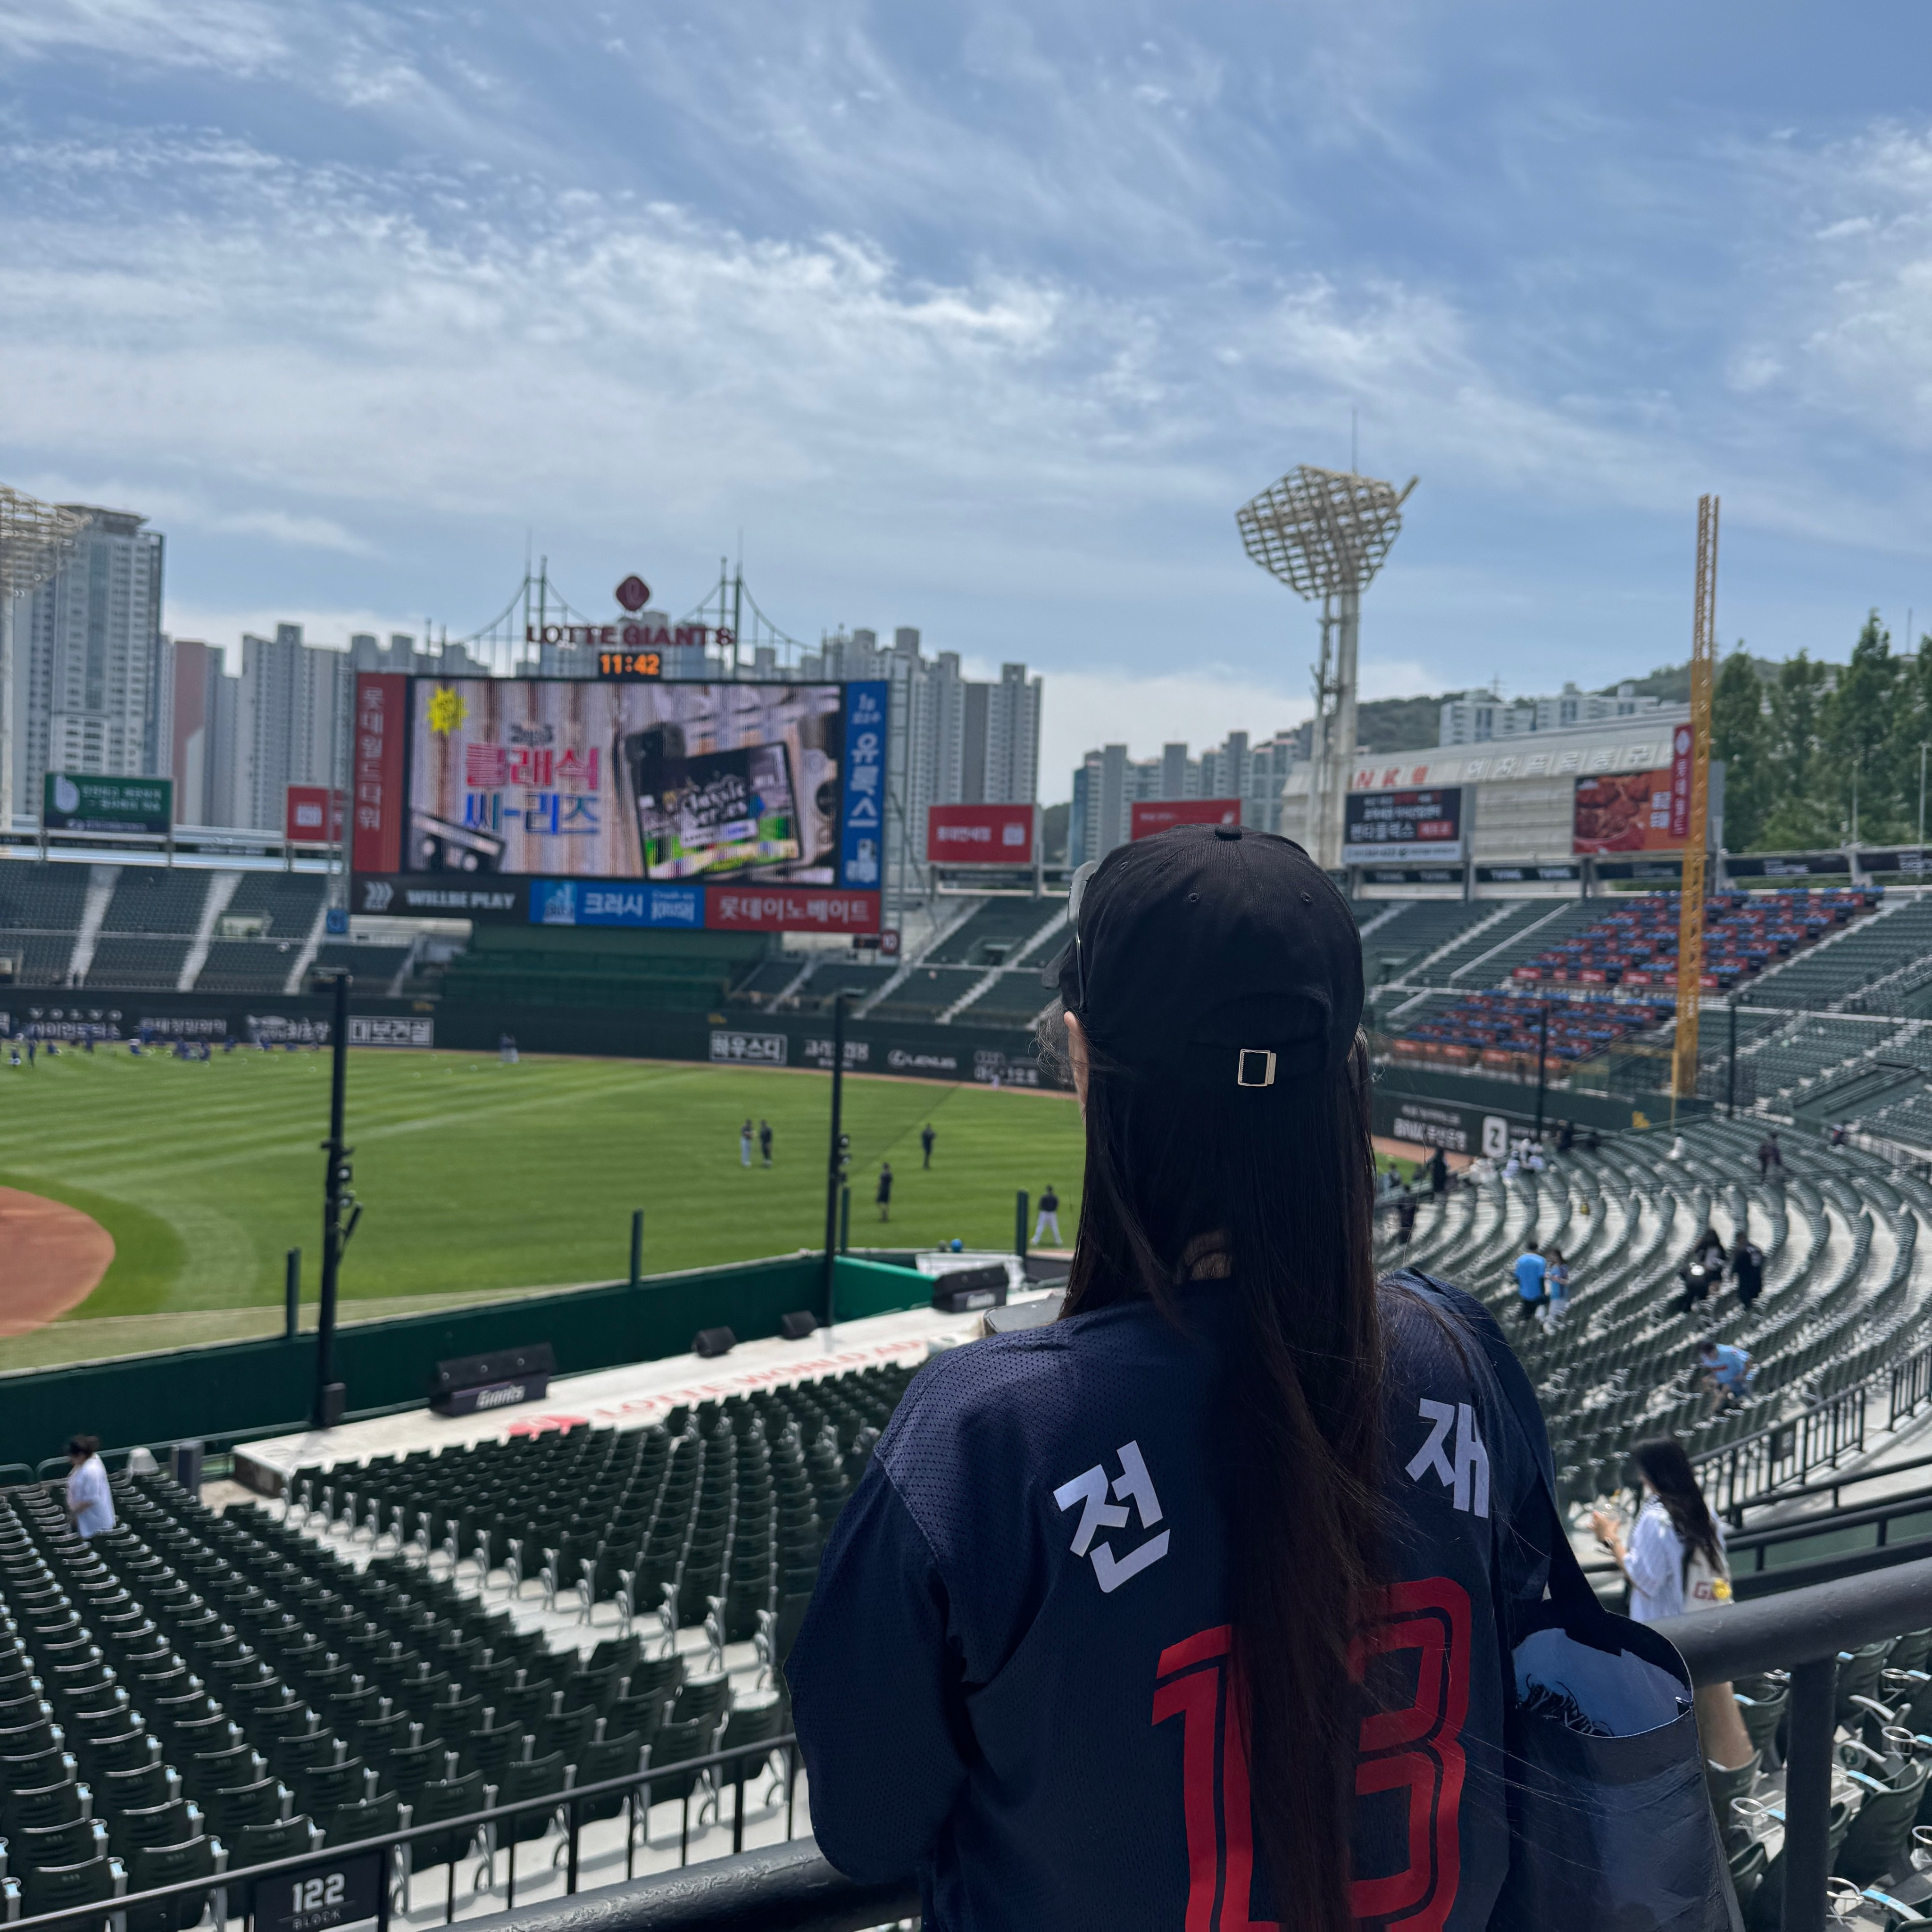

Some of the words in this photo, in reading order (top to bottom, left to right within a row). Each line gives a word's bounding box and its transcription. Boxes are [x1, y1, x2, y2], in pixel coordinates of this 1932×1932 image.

[526, 625, 617, 644] LOTTE
[622, 625, 734, 646] GIANTS
[600, 654, 660, 675] 11:42
[719, 896, 870, 924] 롯데이노베이트
[292, 1872, 345, 1914] 122
[292, 1908, 341, 1931] BLOCK
